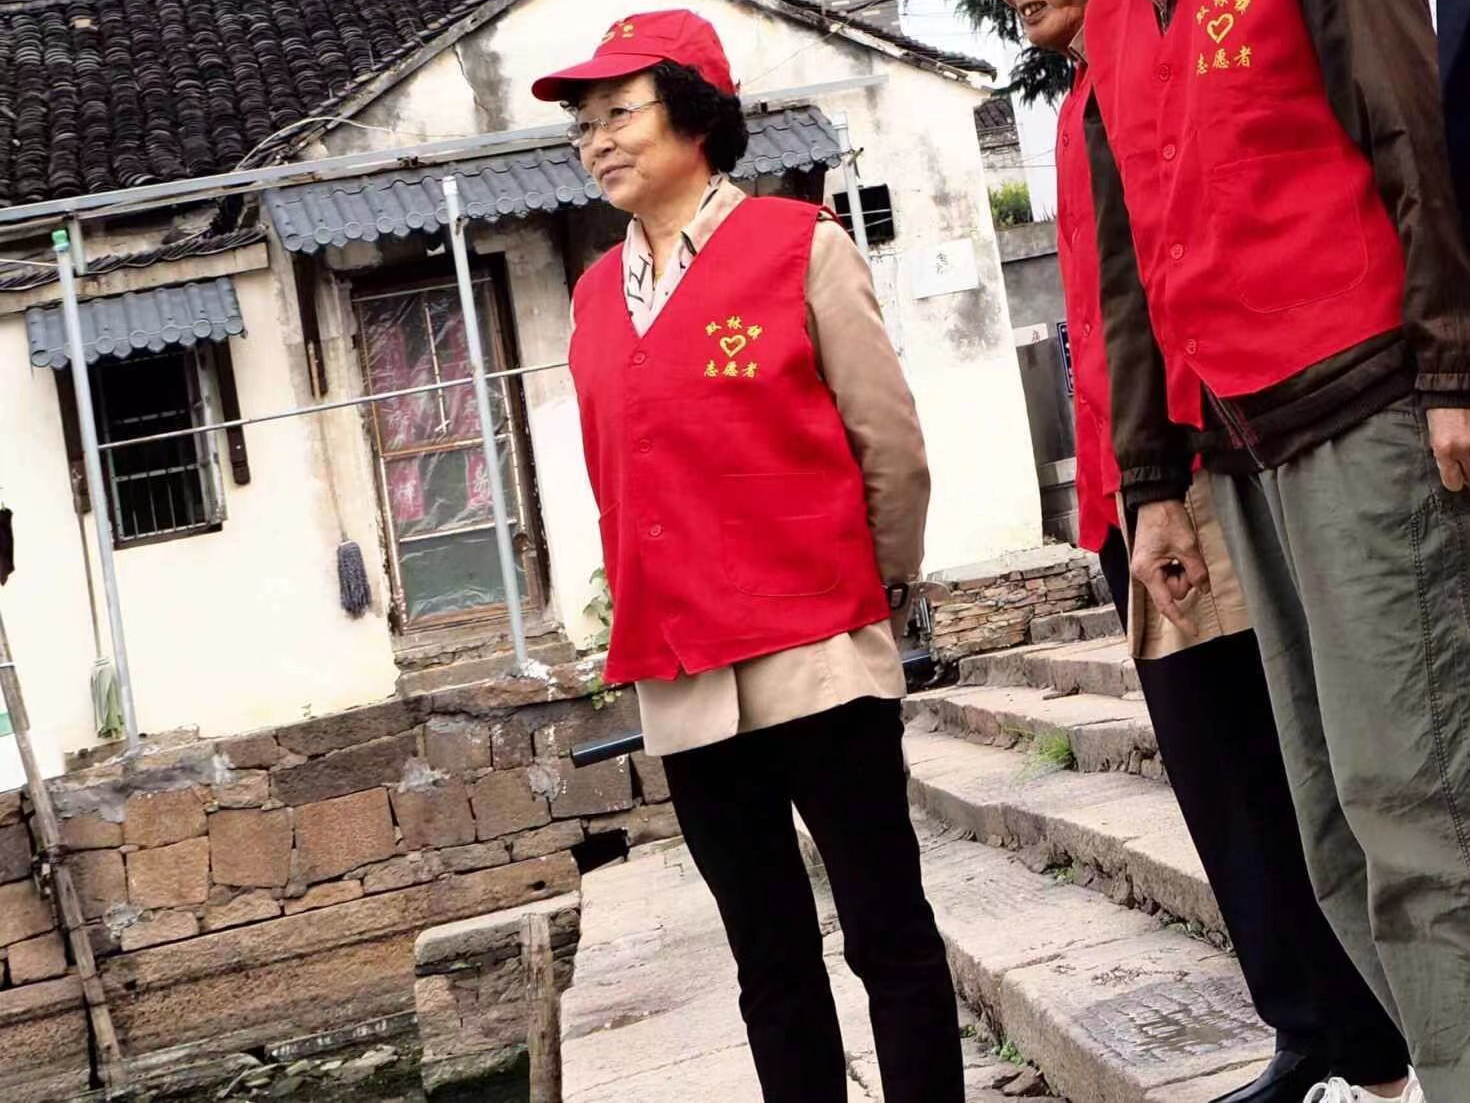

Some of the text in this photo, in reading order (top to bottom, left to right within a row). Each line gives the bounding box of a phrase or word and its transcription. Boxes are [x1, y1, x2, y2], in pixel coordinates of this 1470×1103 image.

[1196, 45, 1252, 75] 志愿者
[704, 359, 758, 378] 志愿者
